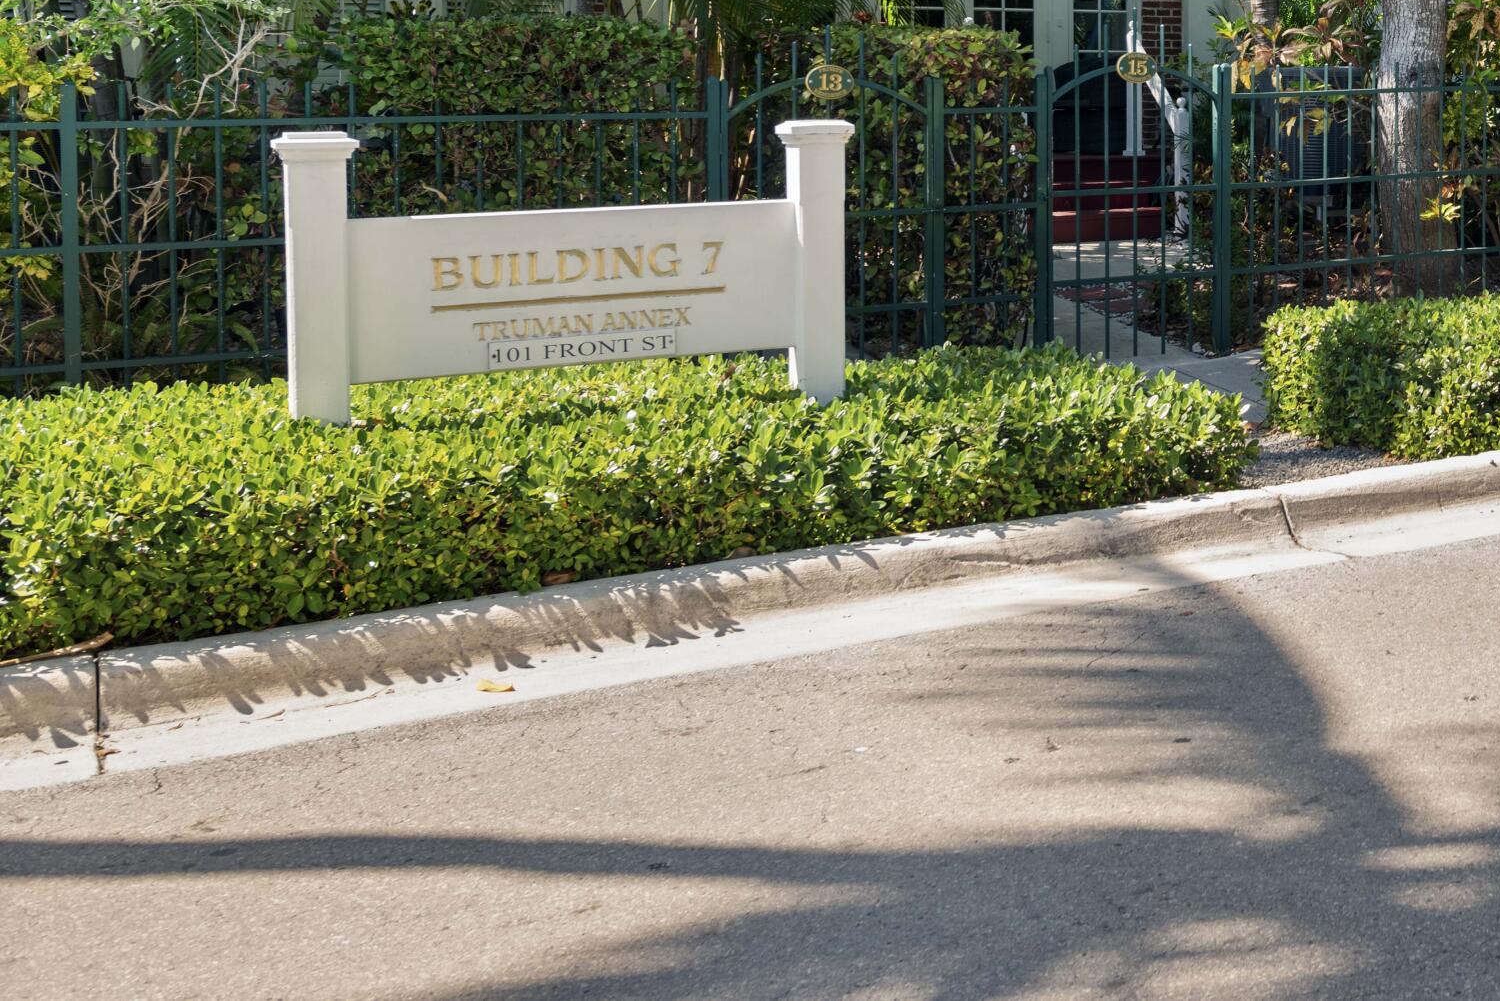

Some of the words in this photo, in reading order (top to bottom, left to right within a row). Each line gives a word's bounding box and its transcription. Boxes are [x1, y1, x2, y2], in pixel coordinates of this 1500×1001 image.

[1127, 59, 1148, 77] 15
[818, 72, 843, 92] 13
[431, 242, 682, 292] BUILDING
[701, 240, 725, 276] 7
[472, 313, 594, 342] TRUMAN
[600, 306, 692, 332] ANNEX
[495, 345, 532, 364] 101
[543, 337, 634, 361] FRONT
